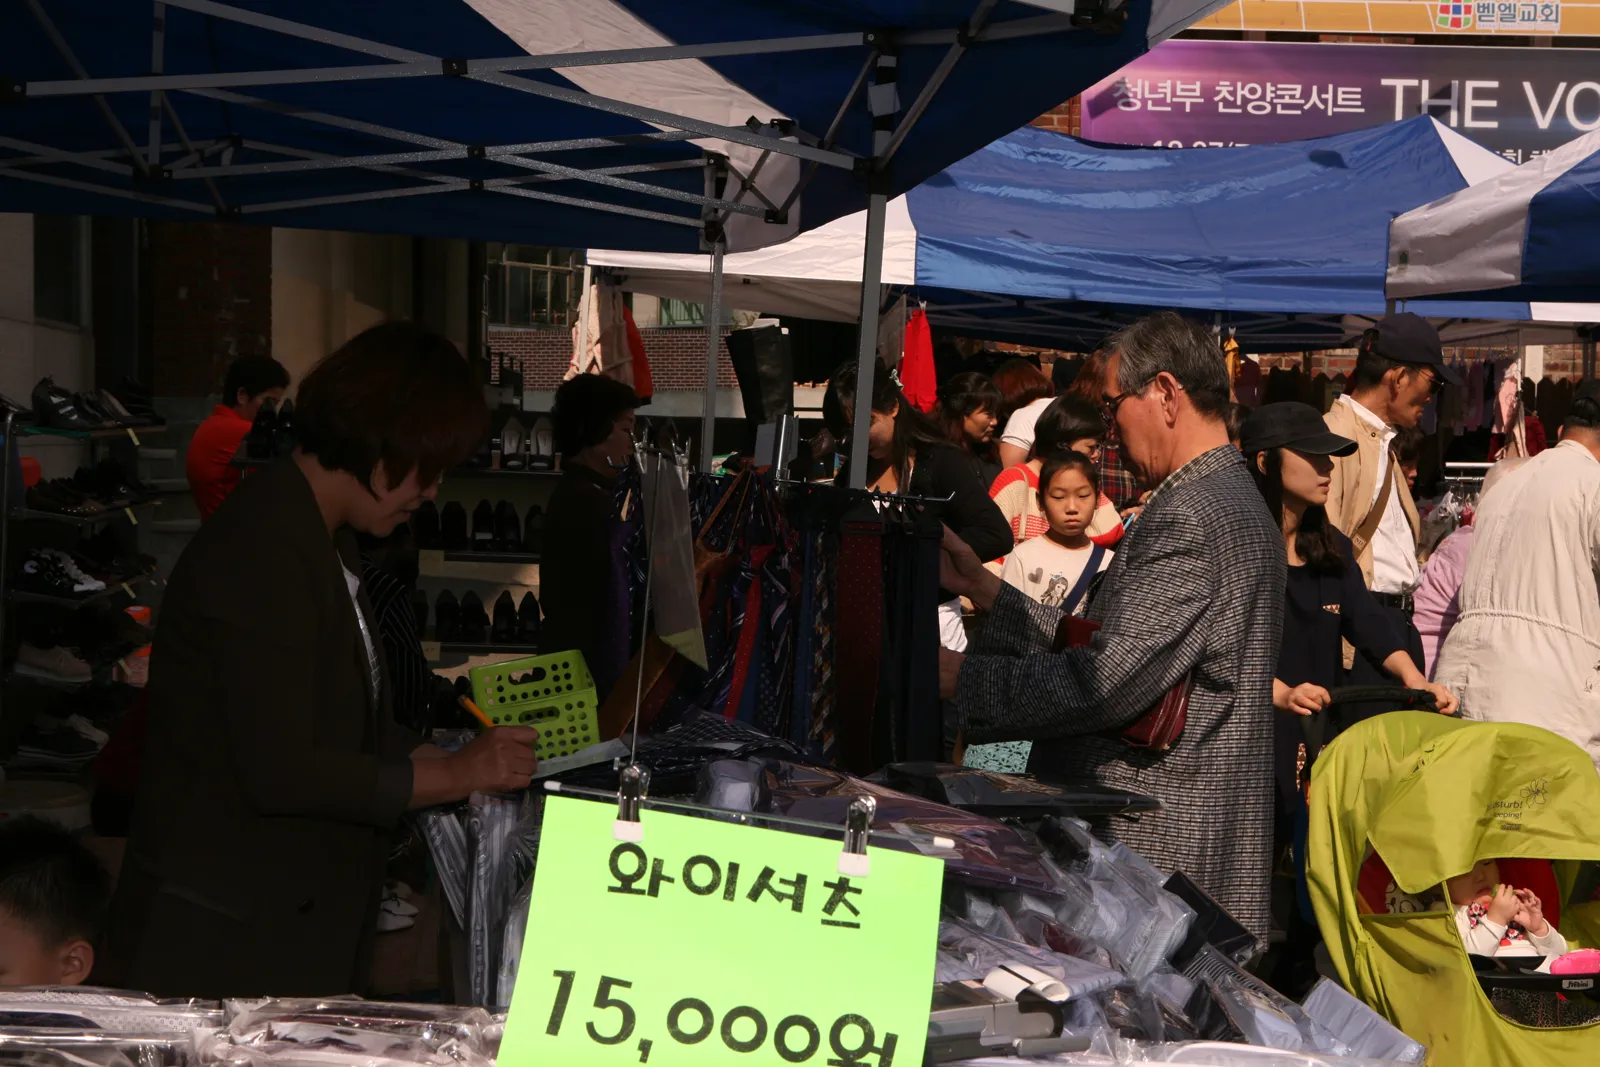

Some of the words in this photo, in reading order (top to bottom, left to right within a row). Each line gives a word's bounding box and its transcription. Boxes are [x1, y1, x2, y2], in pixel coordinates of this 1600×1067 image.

[1477, 3, 1559, 23] 벧엘교회
[1113, 78, 1204, 112] 청년부
[1213, 81, 1365, 116] 찬양콘서트
[1381, 78, 1499, 128] THE
[607, 842, 863, 929] 와이셔츠
[545, 970, 899, 1067] 15,000원
